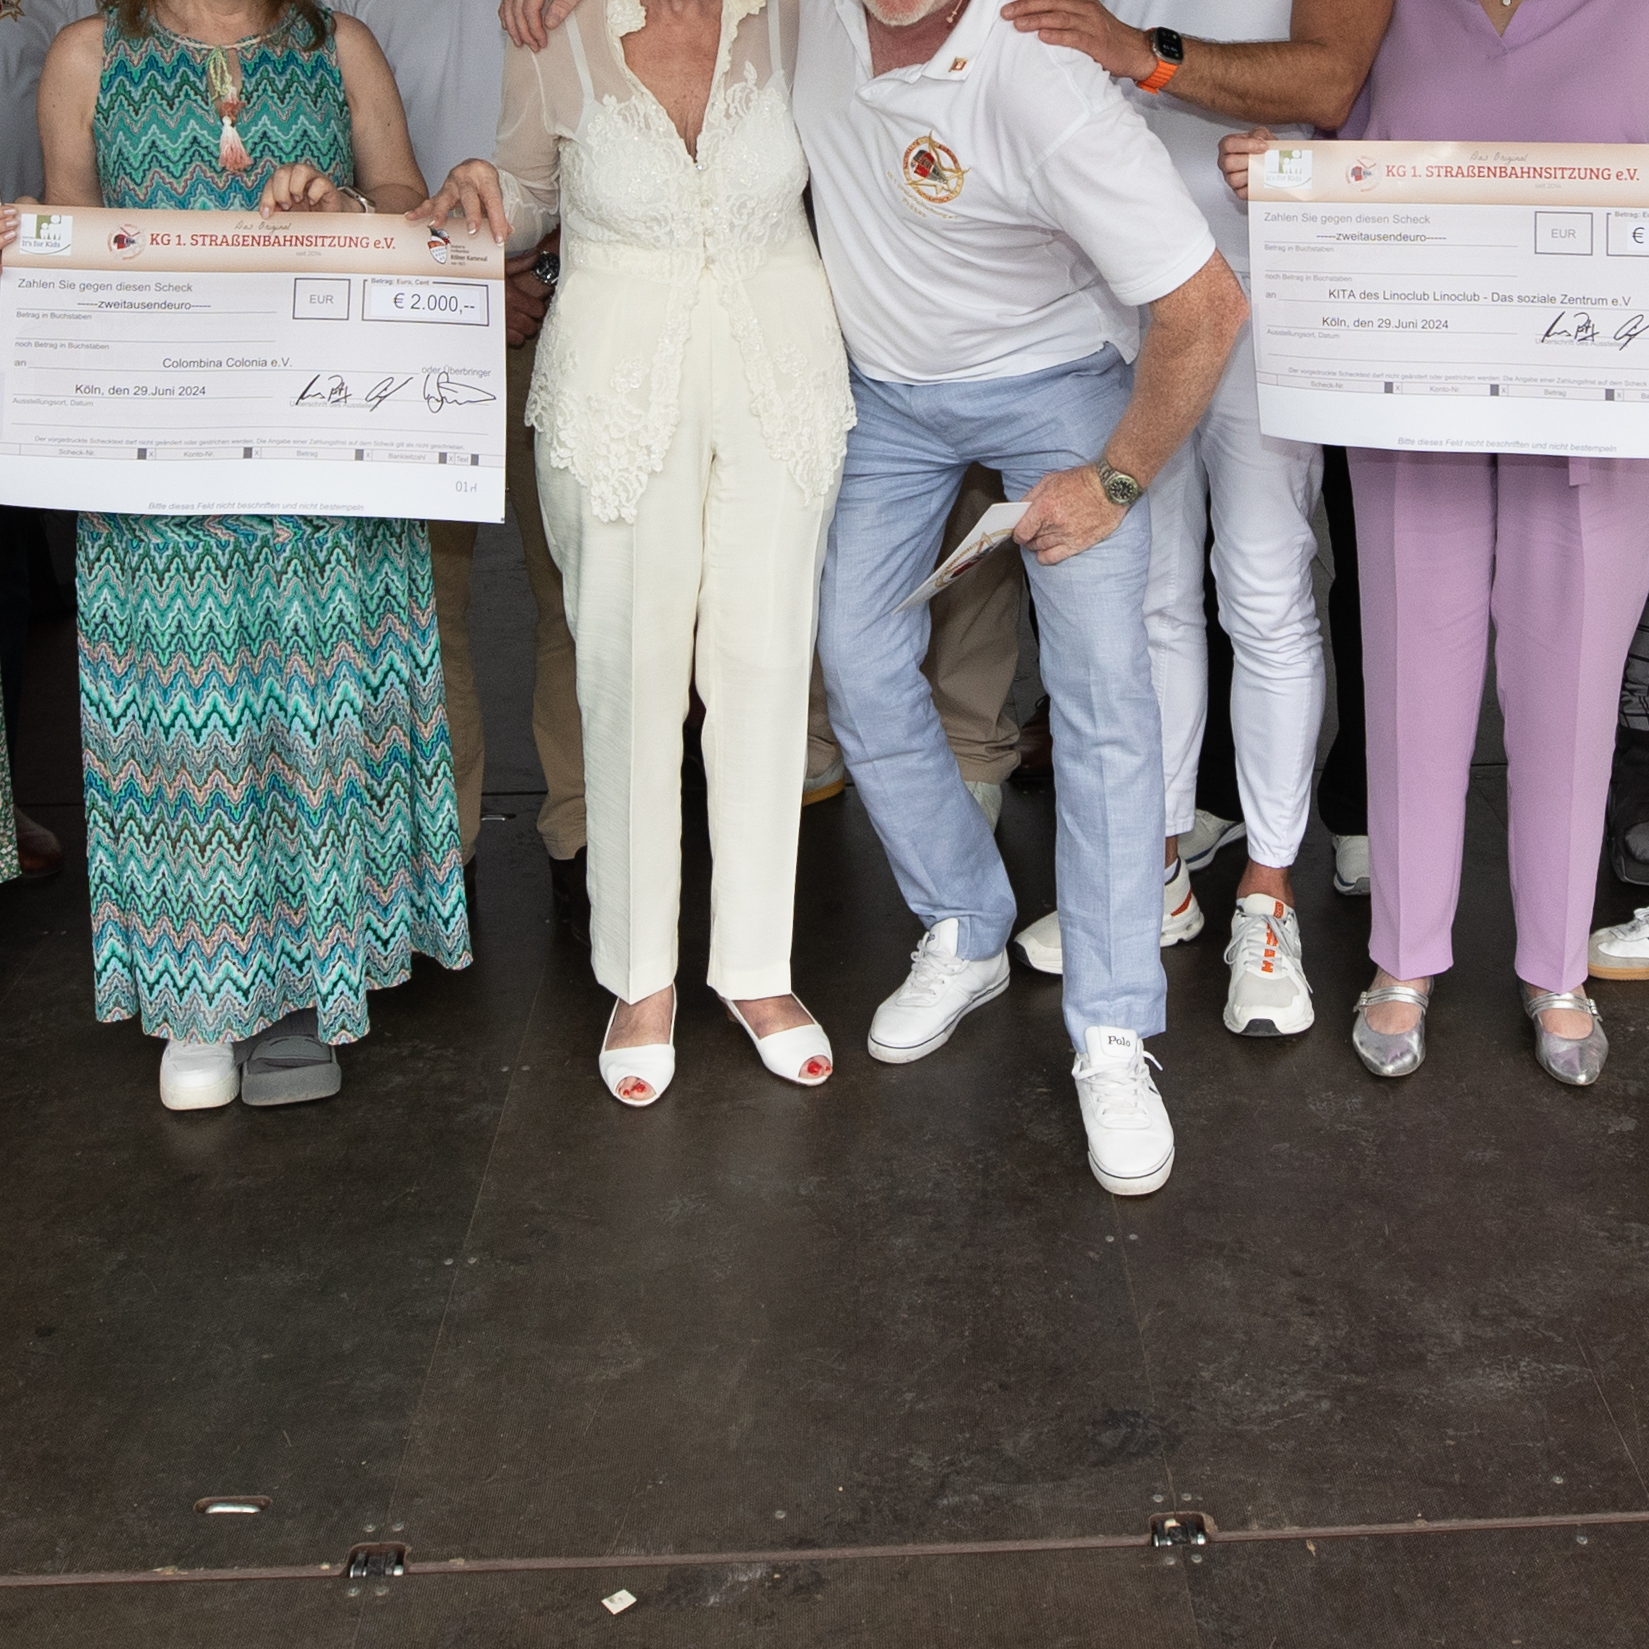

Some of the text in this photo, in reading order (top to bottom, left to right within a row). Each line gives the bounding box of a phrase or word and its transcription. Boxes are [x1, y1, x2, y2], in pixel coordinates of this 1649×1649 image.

[1385, 164, 1640, 181] KG 1. STRAßENBAHNSITZUNG e.V.
[1550, 228, 1577, 239] EUR
[1631, 226, 1645, 245] €
[149, 233, 396, 250] KG 1. STRAßENBAHNSITZUNG e.V.
[17, 278, 193, 293] Zahlen Sie gegen diesen Scheck
[309, 293, 334, 305] EUR
[393, 292, 475, 315] € 2.000,--
[1328, 288, 1632, 307] KITA des Linoclub Linoclub Das soziale Zentrum e.V
[1322, 316, 1449, 330] Köln, den 29.Juni 2024
[162, 357, 293, 369] Colombina Colonia e.V.
[421, 364, 492, 379] oder Überbringer
[74, 384, 206, 397] Köln, den 29.Juni 2024
